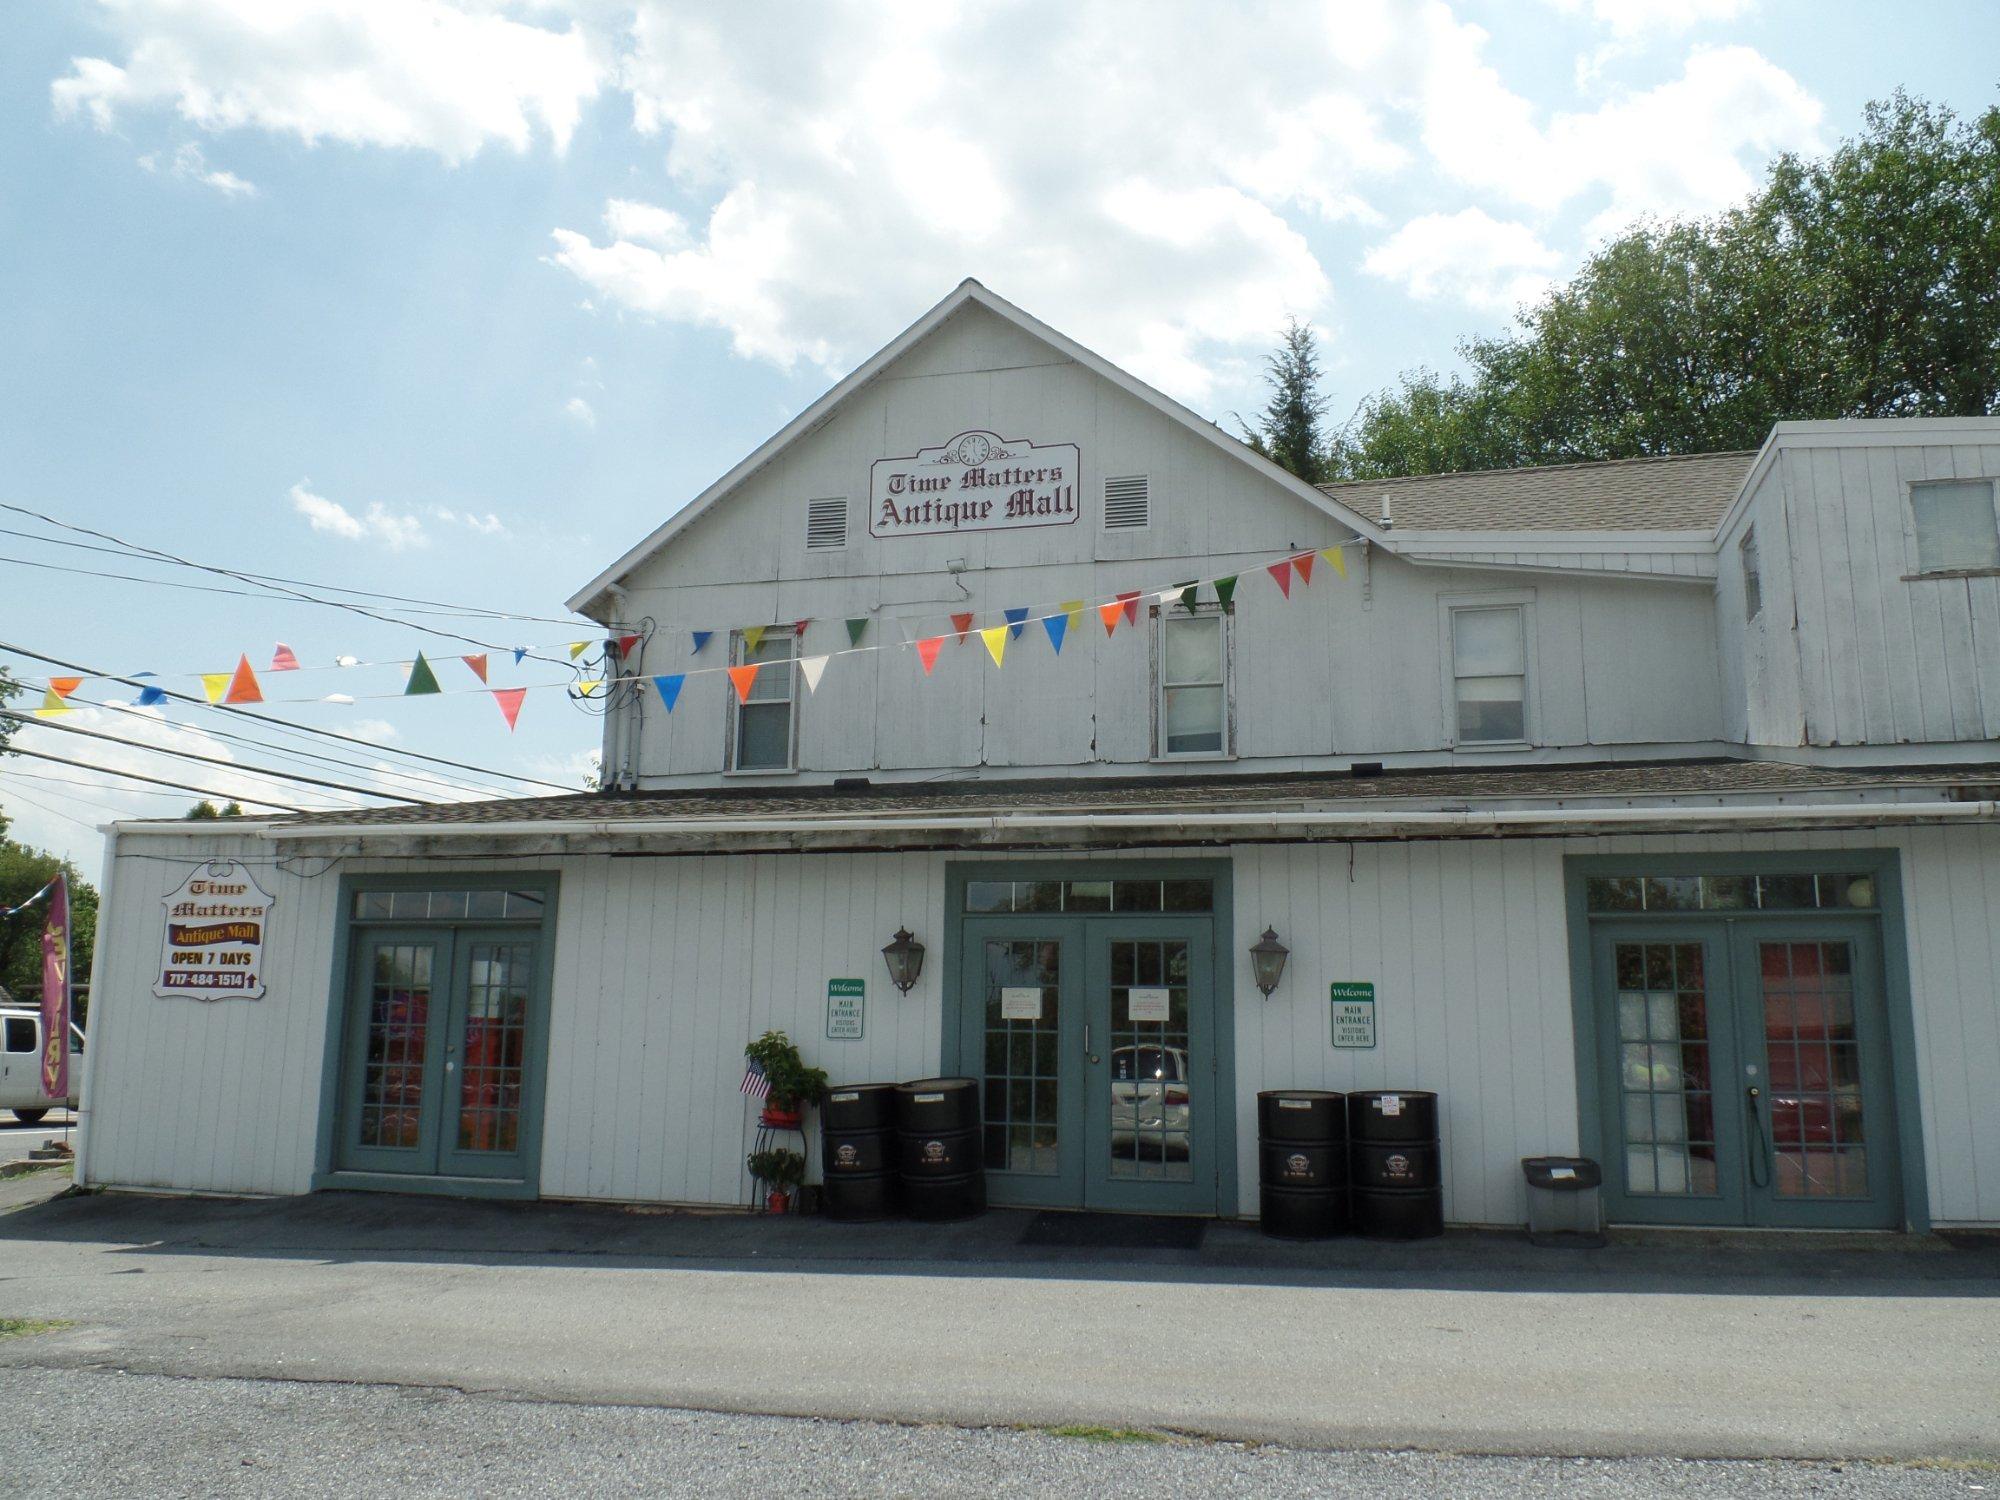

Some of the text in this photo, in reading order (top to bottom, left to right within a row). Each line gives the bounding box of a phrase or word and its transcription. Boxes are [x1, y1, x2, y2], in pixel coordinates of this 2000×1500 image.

[887, 466, 1063, 495] Time Matters
[876, 485, 1074, 528] Antique Mall
[189, 880, 247, 895] Time
[171, 902, 263, 917] Matters
[176, 924, 254, 944] Antique Mall
[171, 952, 251, 965] OPEN 7 DAYS
[169, 973, 243, 986] 717-484-1514
[831, 984, 863, 992] Welcome
[1333, 988, 1372, 997] Welcome
[838, 1000, 853, 1008] MAIN
[1344, 1005, 1362, 1014] MAIN
[831, 1009, 860, 1017] ENTRANCE
[1336, 1016, 1371, 1024] ENTRANCE
